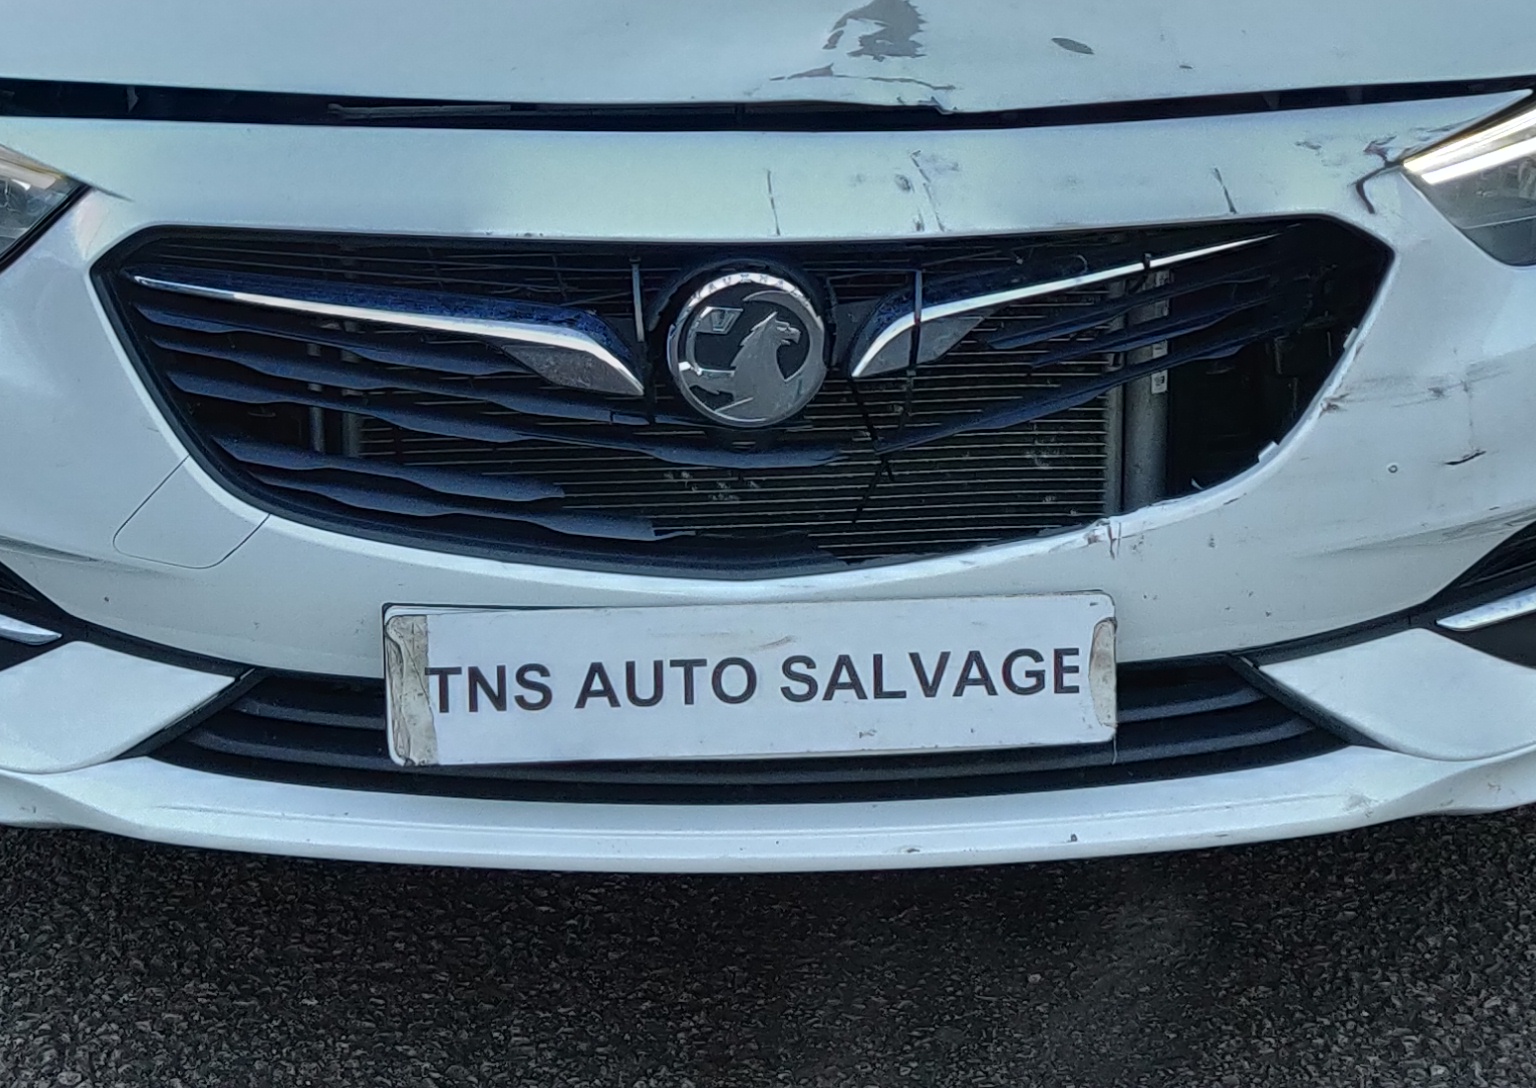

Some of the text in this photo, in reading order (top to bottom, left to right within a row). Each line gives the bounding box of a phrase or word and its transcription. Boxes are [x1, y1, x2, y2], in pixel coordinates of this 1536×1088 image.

[424, 646, 1081, 714] TNS AUTO SALVAGE
